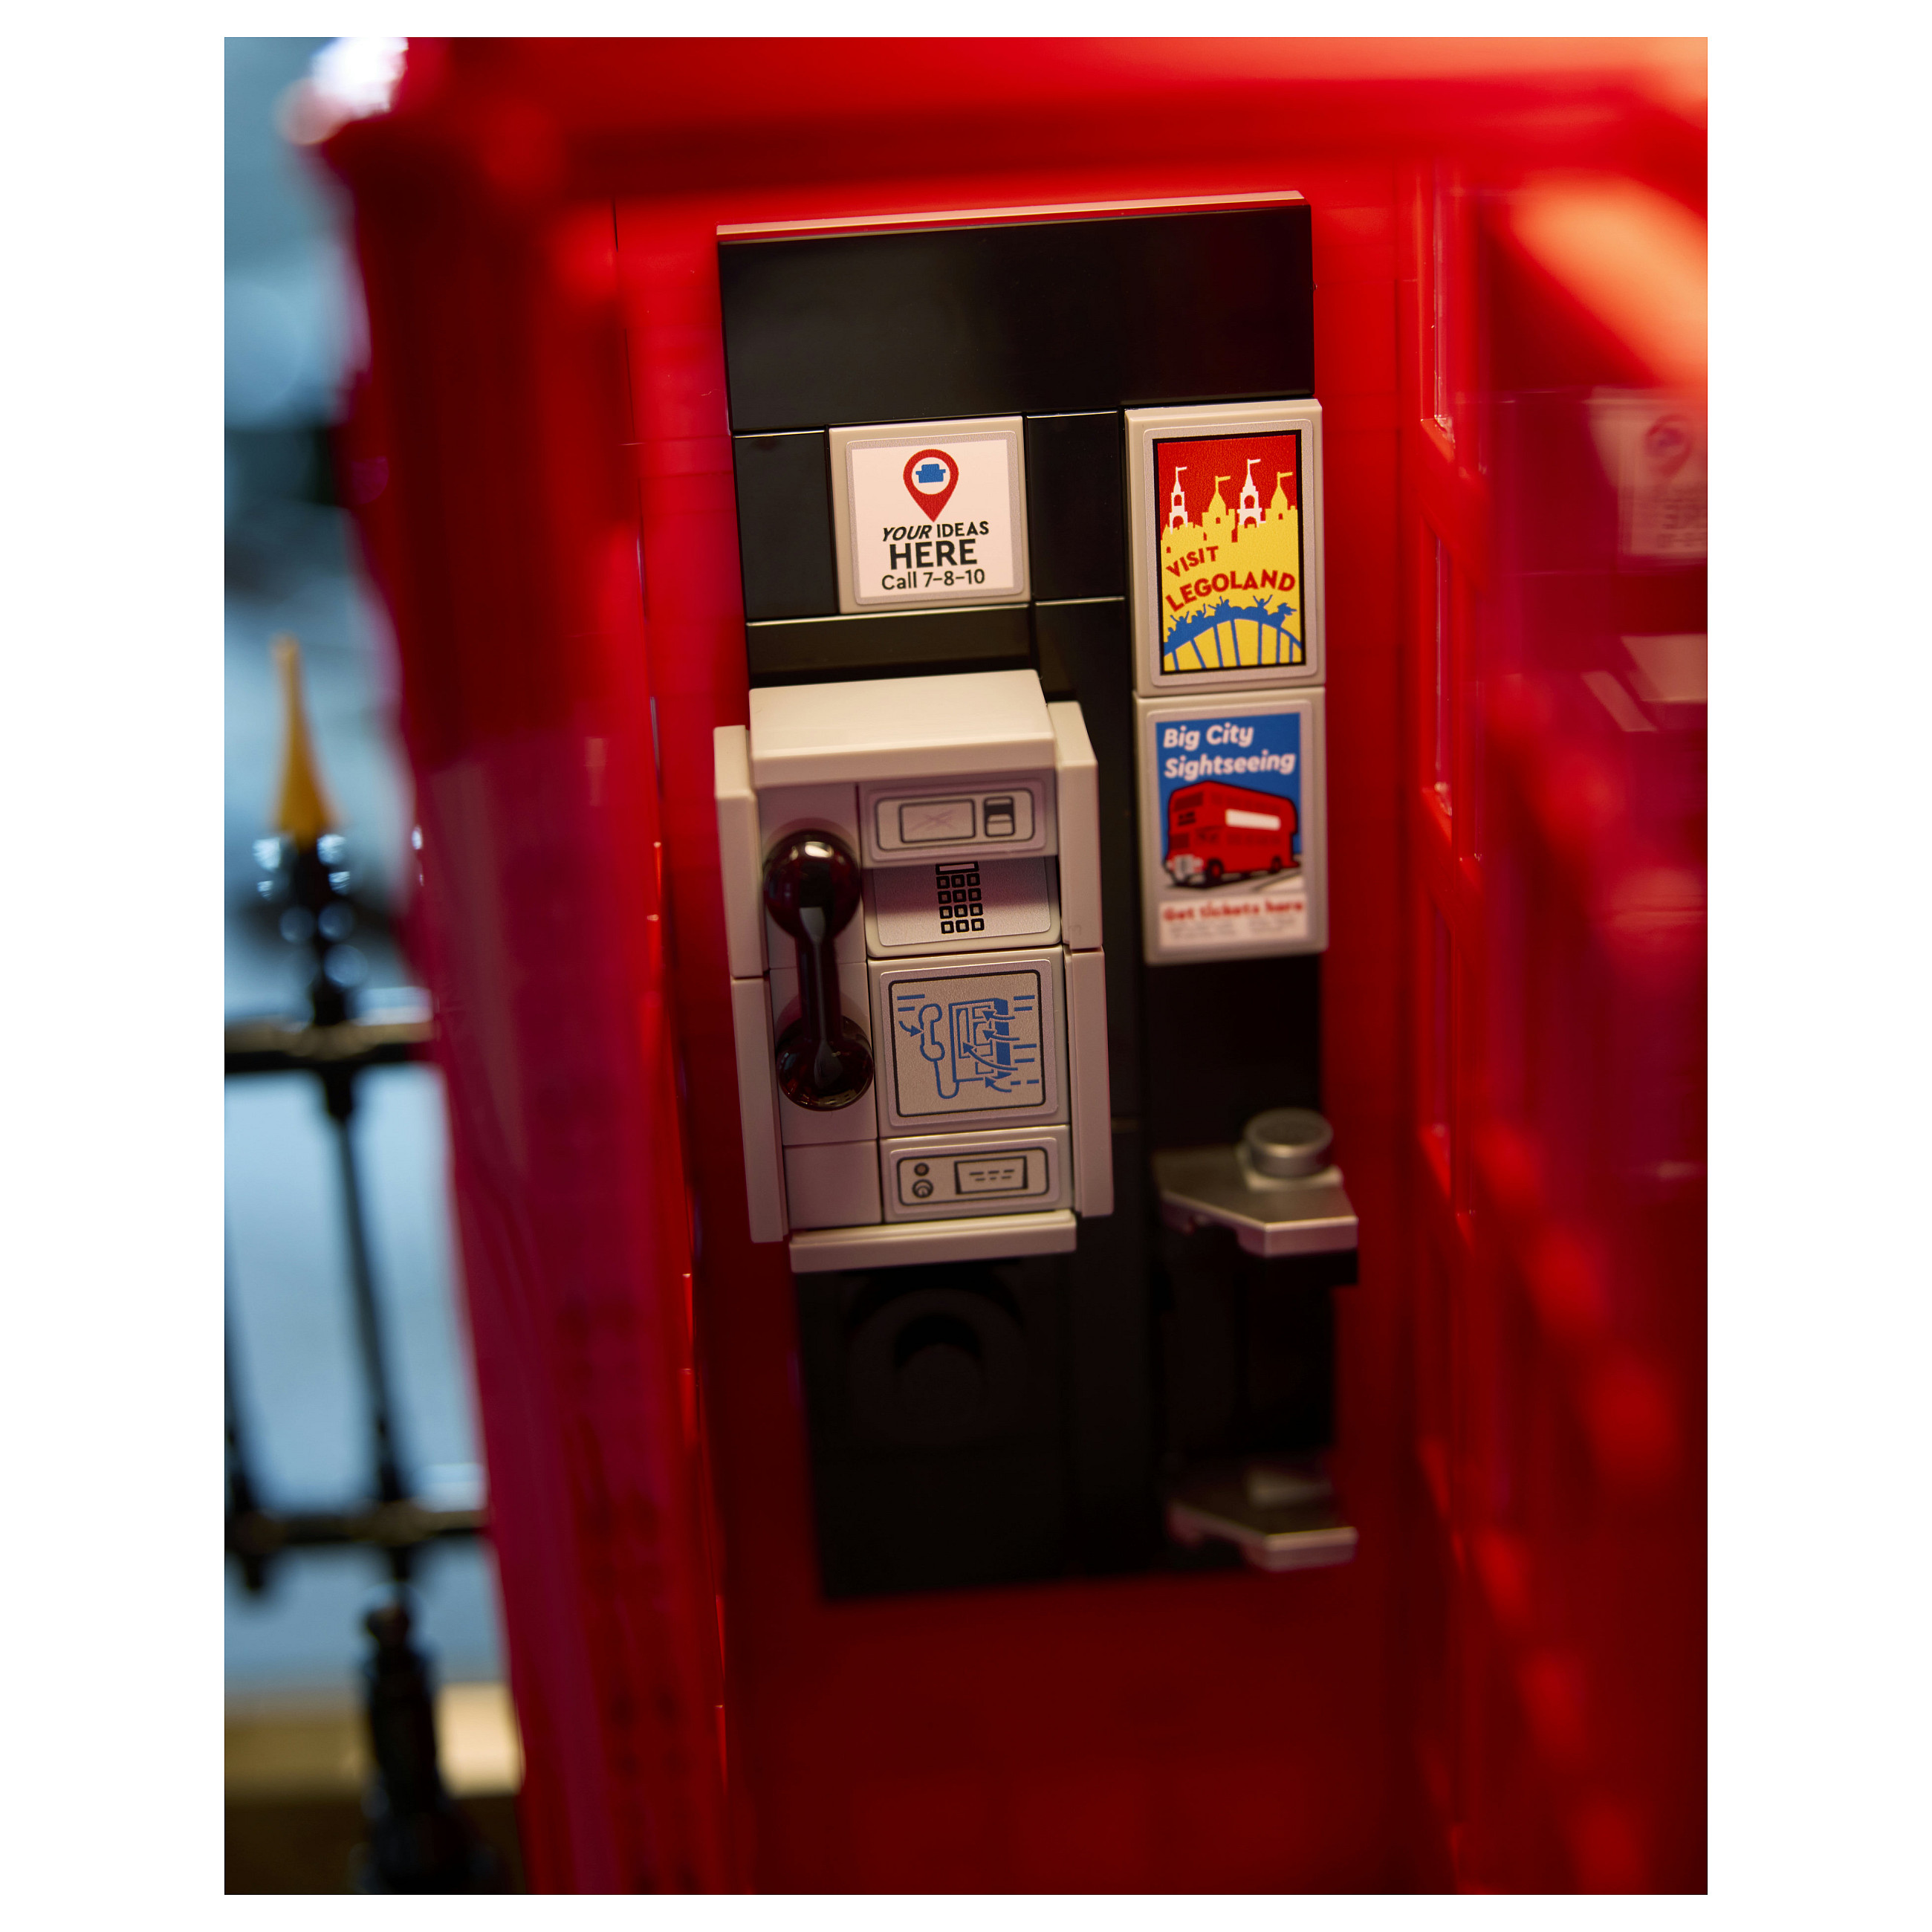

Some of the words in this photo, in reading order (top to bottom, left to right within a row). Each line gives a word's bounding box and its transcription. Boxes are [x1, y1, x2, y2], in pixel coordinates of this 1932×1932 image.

[882, 525, 932, 542] YOUR
[937, 521, 989, 537] IDEAS
[889, 539, 977, 570] HERE
[1166, 545, 1219, 577] VISIT
[881, 571, 917, 590] Call
[923, 568, 985, 588] 7-8-10
[1166, 569, 1296, 612] LEGOLAND
[1164, 725, 1200, 751] Big
[1206, 722, 1254, 747] City
[1164, 750, 1296, 781] Sightseeing
[1163, 907, 1195, 921] Get
[1199, 901, 1260, 918] tickets
[1265, 900, 1303, 914] here
